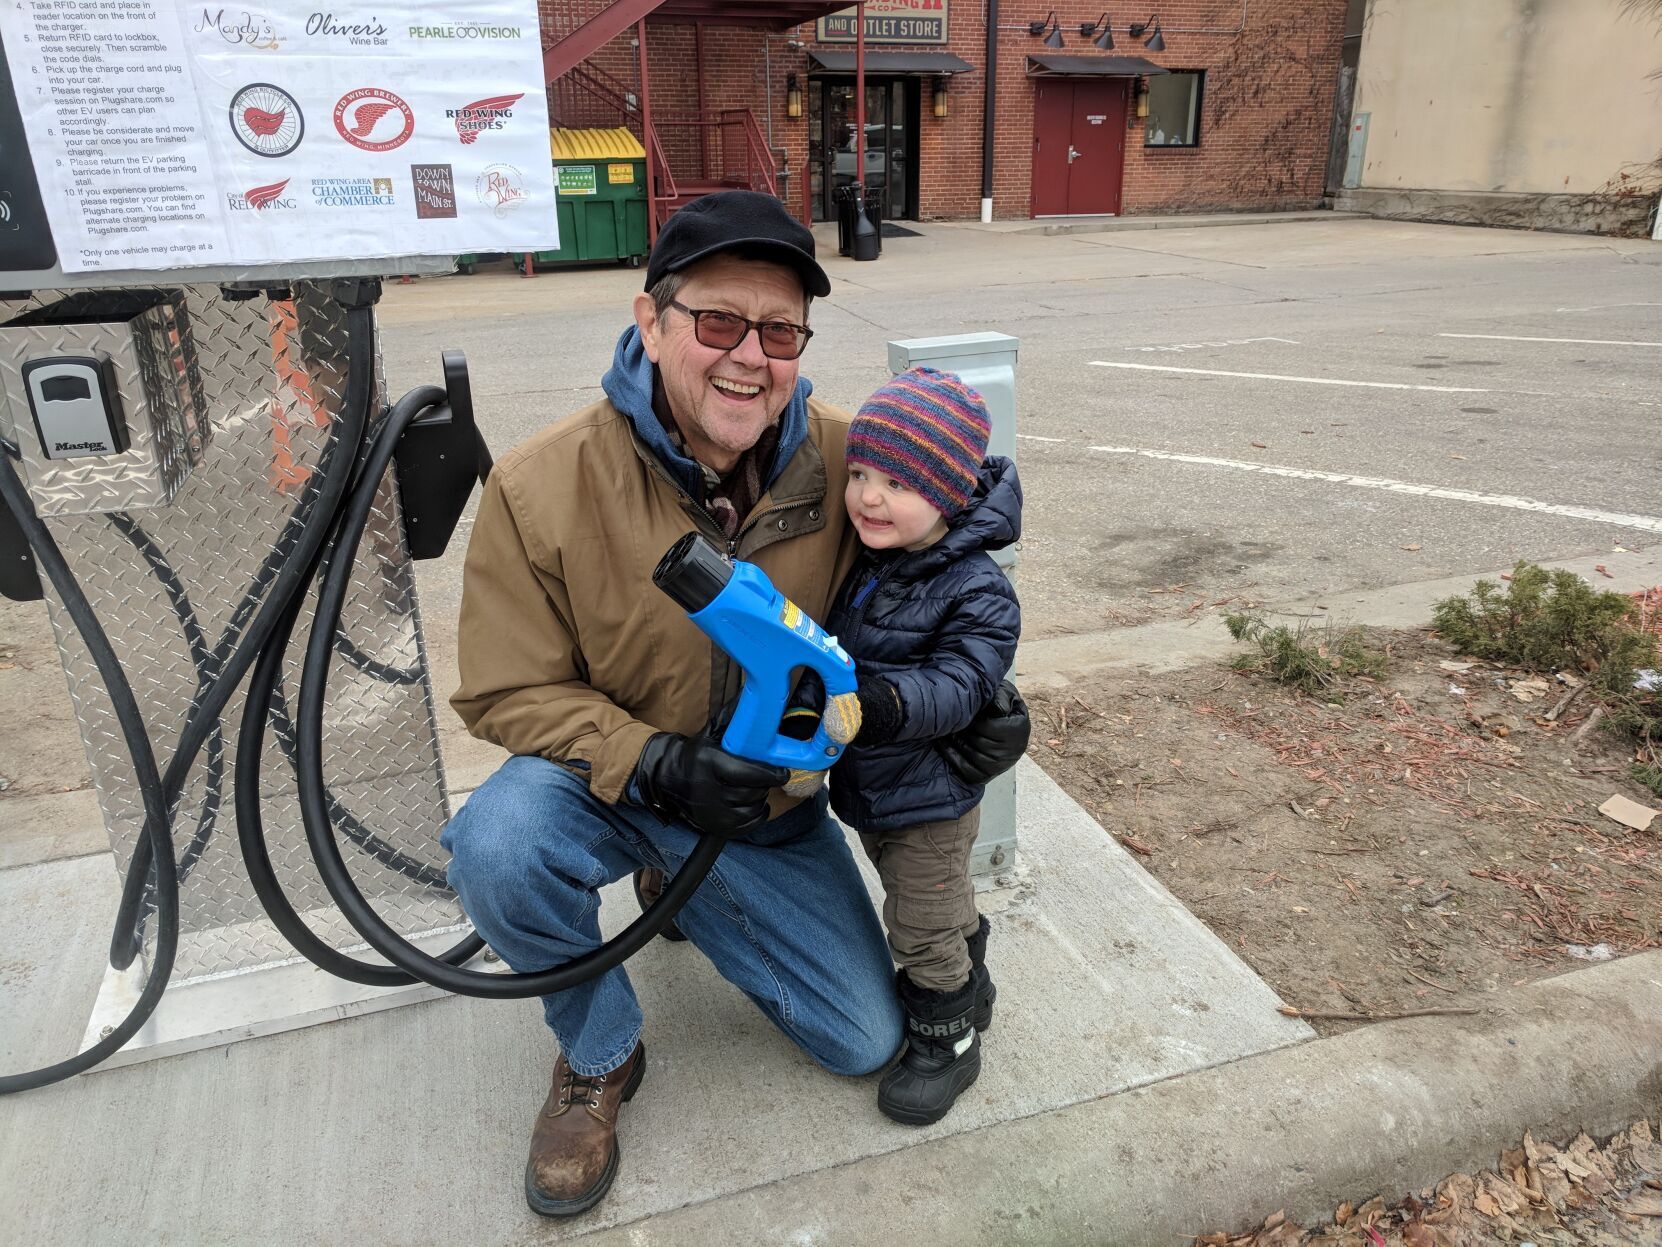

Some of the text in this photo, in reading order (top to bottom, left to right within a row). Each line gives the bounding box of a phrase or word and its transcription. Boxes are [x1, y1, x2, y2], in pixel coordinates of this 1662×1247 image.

[16, 2, 25, 10] 4.
[31, 1, 51, 10] Take
[54, 1, 76, 9] RFID
[78, 1, 98, 9] card
[100, 1, 116, 9] and
[118, 1, 140, 11] place
[33, 12, 60, 20] reader
[63, 12, 96, 20] location
[111, 12, 124, 20] the
[126, 12, 146, 20] front
[148, 12, 156, 20] of
[51, 23, 86, 32] charger.
[194, 8, 271, 44] Mandy's
[305, 12, 387, 36] Oliver's
[828, 19, 847, 30] AND
[900, 21, 938, 36] STORE
[409, 26, 520, 38] PEARLE VISION
[38, 34, 67, 42] Return
[350, 37, 388, 46] Wine Bar
[41, 45, 63, 53] close
[105, 43, 127, 52] Then
[130, 43, 167, 51] scramble
[60, 55, 80, 63] code
[82, 54, 104, 63] dials.
[67, 67, 77, 75] up
[96, 65, 124, 74] charge
[164, 65, 182, 74] plug
[48, 76, 64, 84] into
[66, 77, 86, 85] your
[51, 87, 81, 95] Please
[82, 86, 114, 95] register
[117, 87, 134, 95] your
[137, 86, 165, 95] charge
[54, 97, 86, 105] session
[101, 96, 163, 106] Plugshare.com
[335, 90, 410, 116] RED WING BREWERY
[56, 108, 78, 116] other
[81, 107, 94, 115] EV
[138, 106, 156, 115] plan
[445, 108, 513, 118] RED WING
[59, 118, 109, 127] accordingly.
[61, 128, 91, 136] Please
[93, 127, 103, 135] be
[104, 126, 153, 135] considerate
[64, 139, 83, 147] your
[123, 138, 138, 146] you
[155, 135, 187, 143] finished
[70, 158, 98, 166] Please
[100, 157, 125, 165] return
[126, 156, 140, 164] the
[142, 156, 154, 164] EV
[156, 155, 186, 164] parking
[72, 164, 197, 176] barricade in front of the parking
[416, 168, 449, 180] DOWN
[85, 189, 100, 197] you
[102, 187, 147, 195] experience
[312, 186, 373, 196] CHAMBER
[80, 198, 107, 207] please
[109, 196, 140, 205] register
[141, 196, 159, 204] your
[161, 194, 193, 203] problem
[315, 195, 395, 207] of COMMERCE
[417, 187, 442, 208] MAIN
[181, 203, 196, 211] find
[228, 198, 297, 211] RED WING
[85, 217, 121, 225] alternate
[122, 215, 157, 224] charging
[158, 212, 193, 221] locations
[121, 246, 150, 255] vehicle
[151, 246, 168, 254] may
[170, 244, 196, 253] charge
[55, 442, 103, 451] Master
[910, 1016, 970, 1036] SOREL
